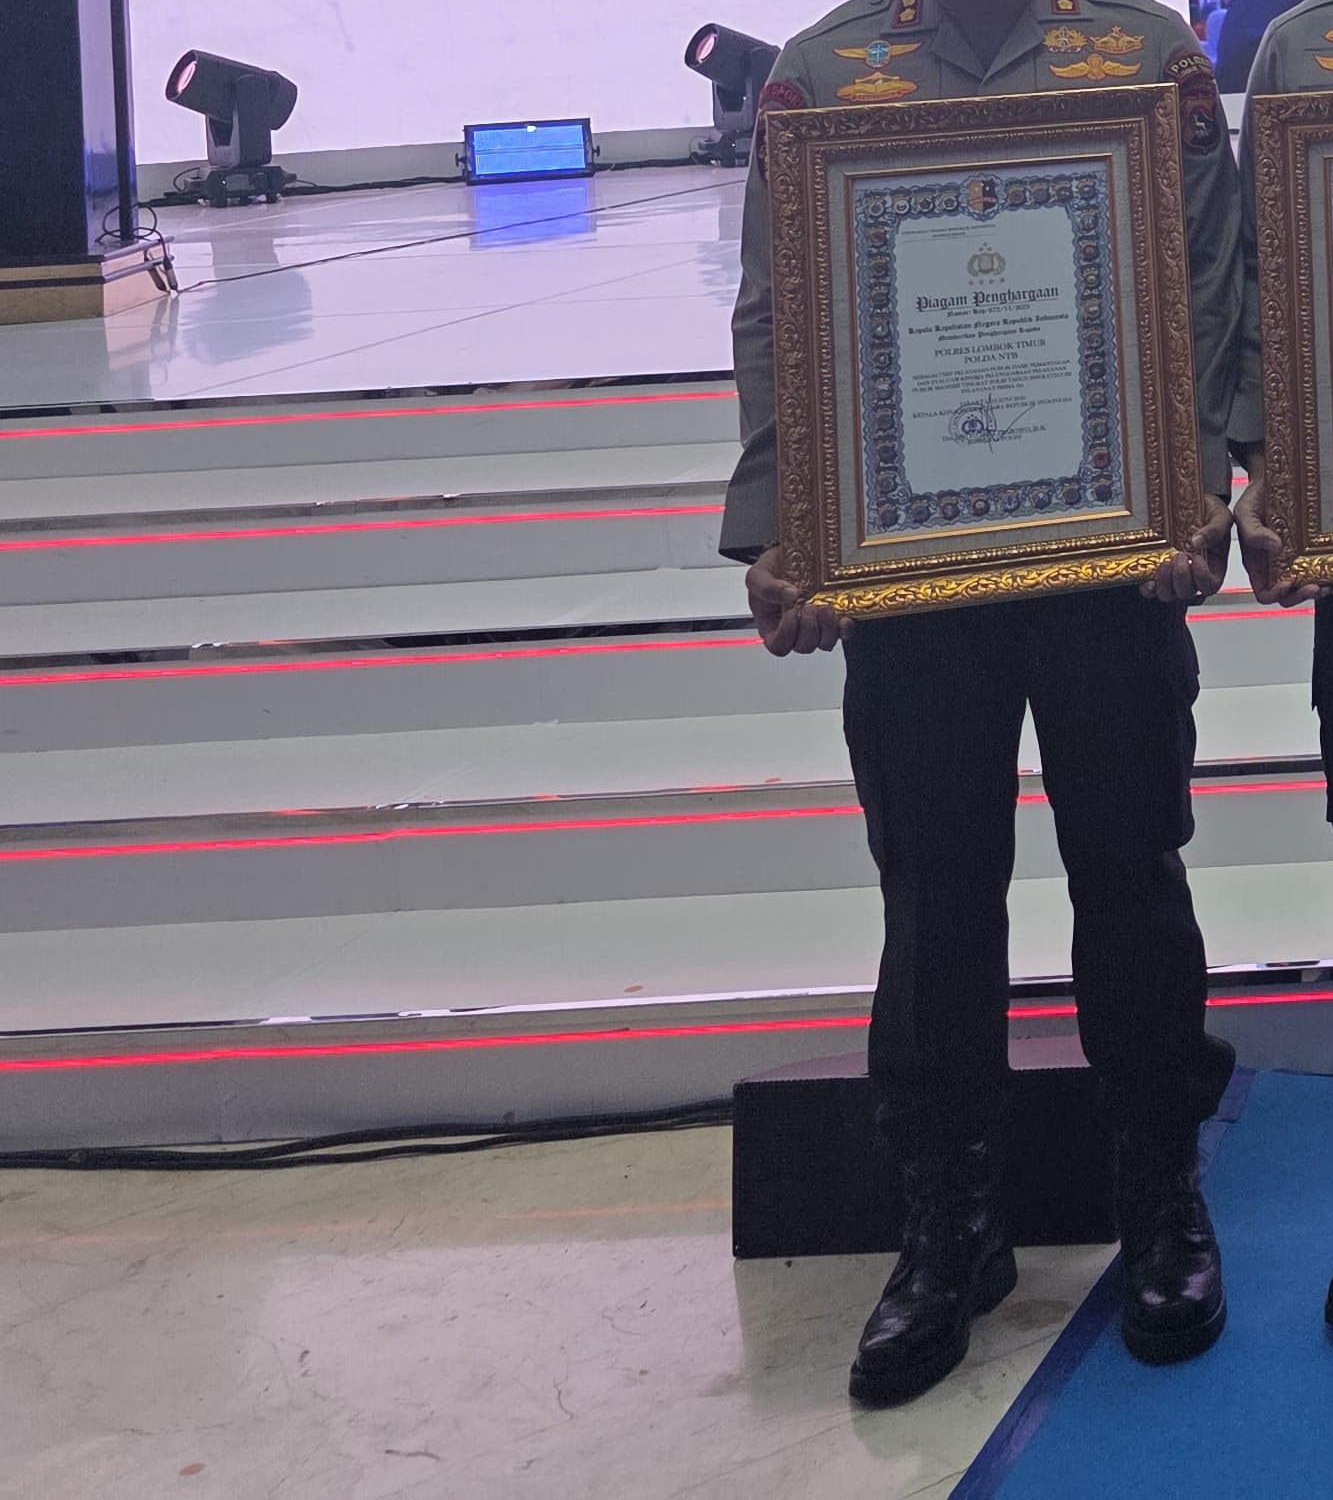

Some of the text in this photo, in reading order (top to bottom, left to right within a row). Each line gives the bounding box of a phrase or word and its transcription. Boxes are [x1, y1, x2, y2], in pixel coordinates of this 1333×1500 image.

[916, 286, 1060, 312] Piagam Penghargaan
[934, 338, 1046, 357] POLRES LOMBOK TIMUR
[964, 351, 1018, 365] POLDA NTB
